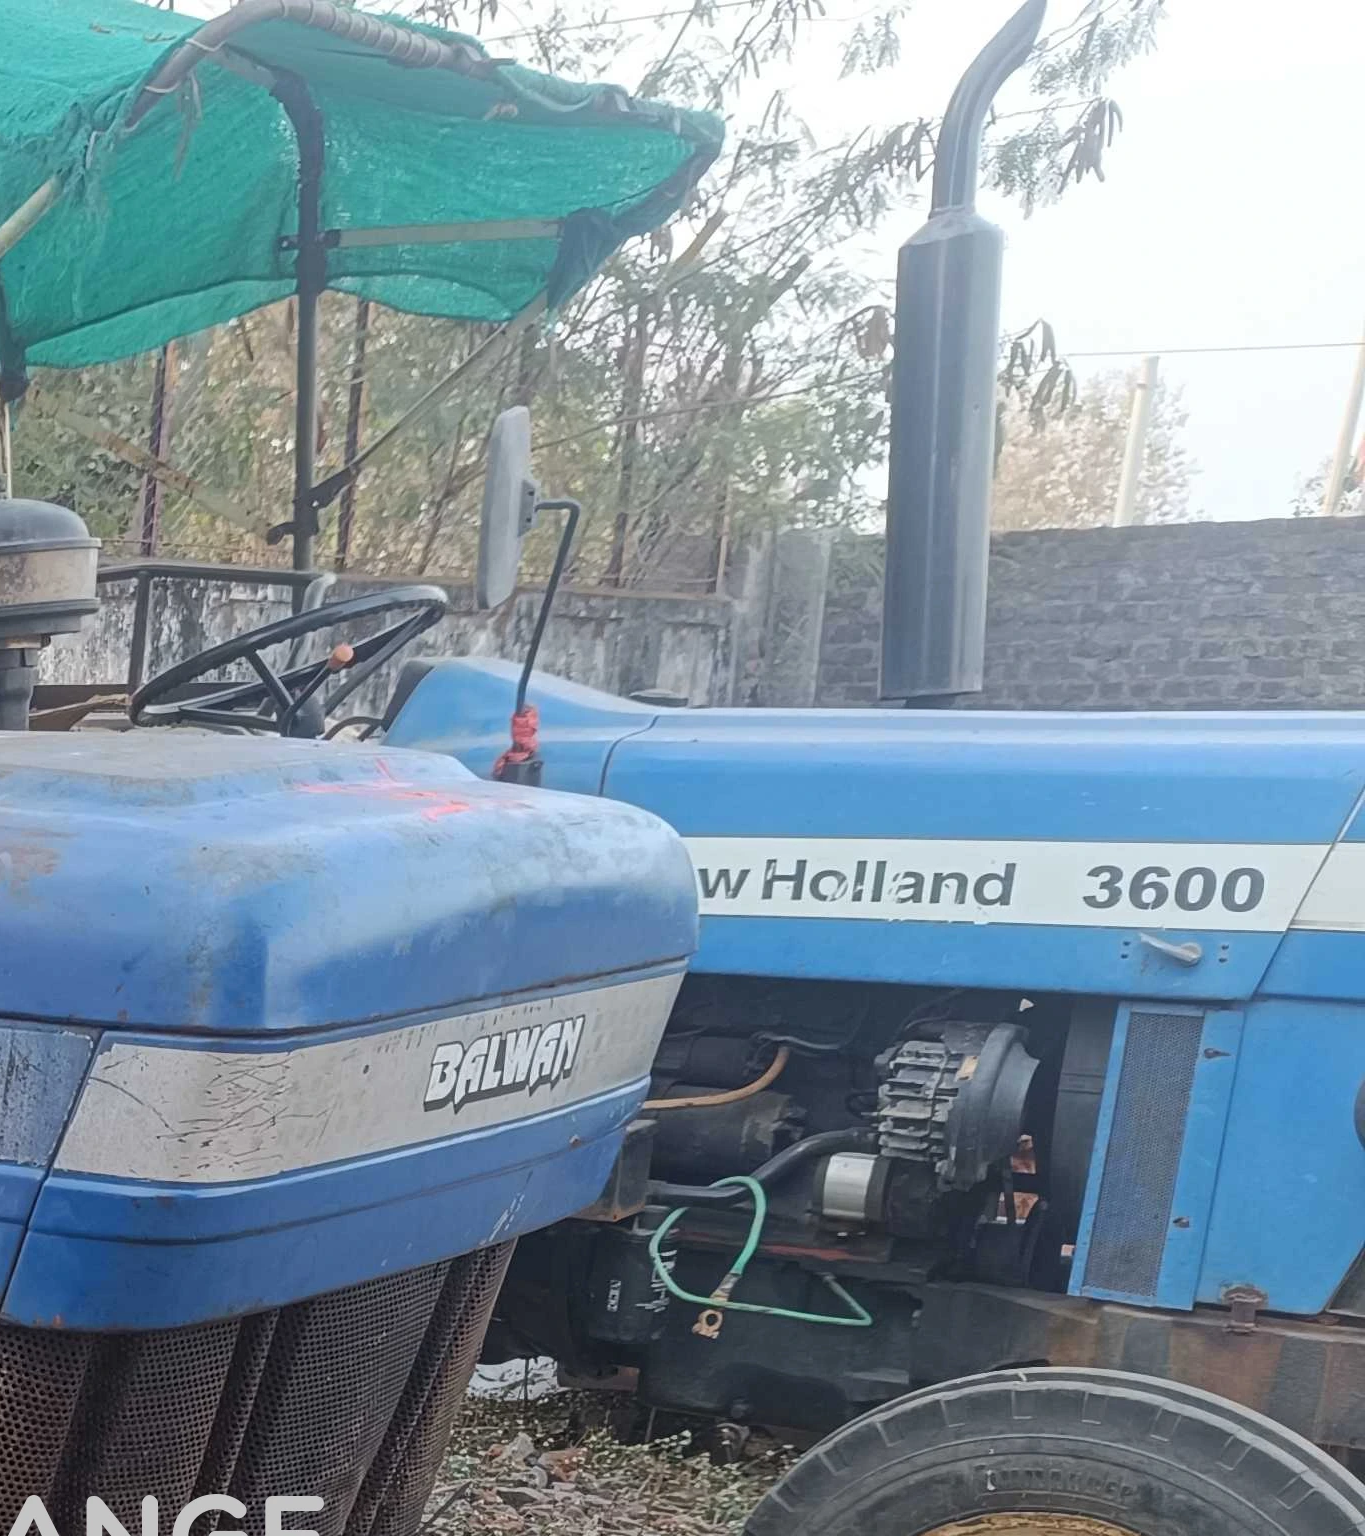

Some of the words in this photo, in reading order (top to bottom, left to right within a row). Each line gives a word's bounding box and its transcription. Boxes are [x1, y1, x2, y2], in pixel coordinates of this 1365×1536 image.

[760, 858, 1017, 907] Holland
[1081, 864, 1266, 913] 3600
[424, 1015, 586, 1108] BALWAN
